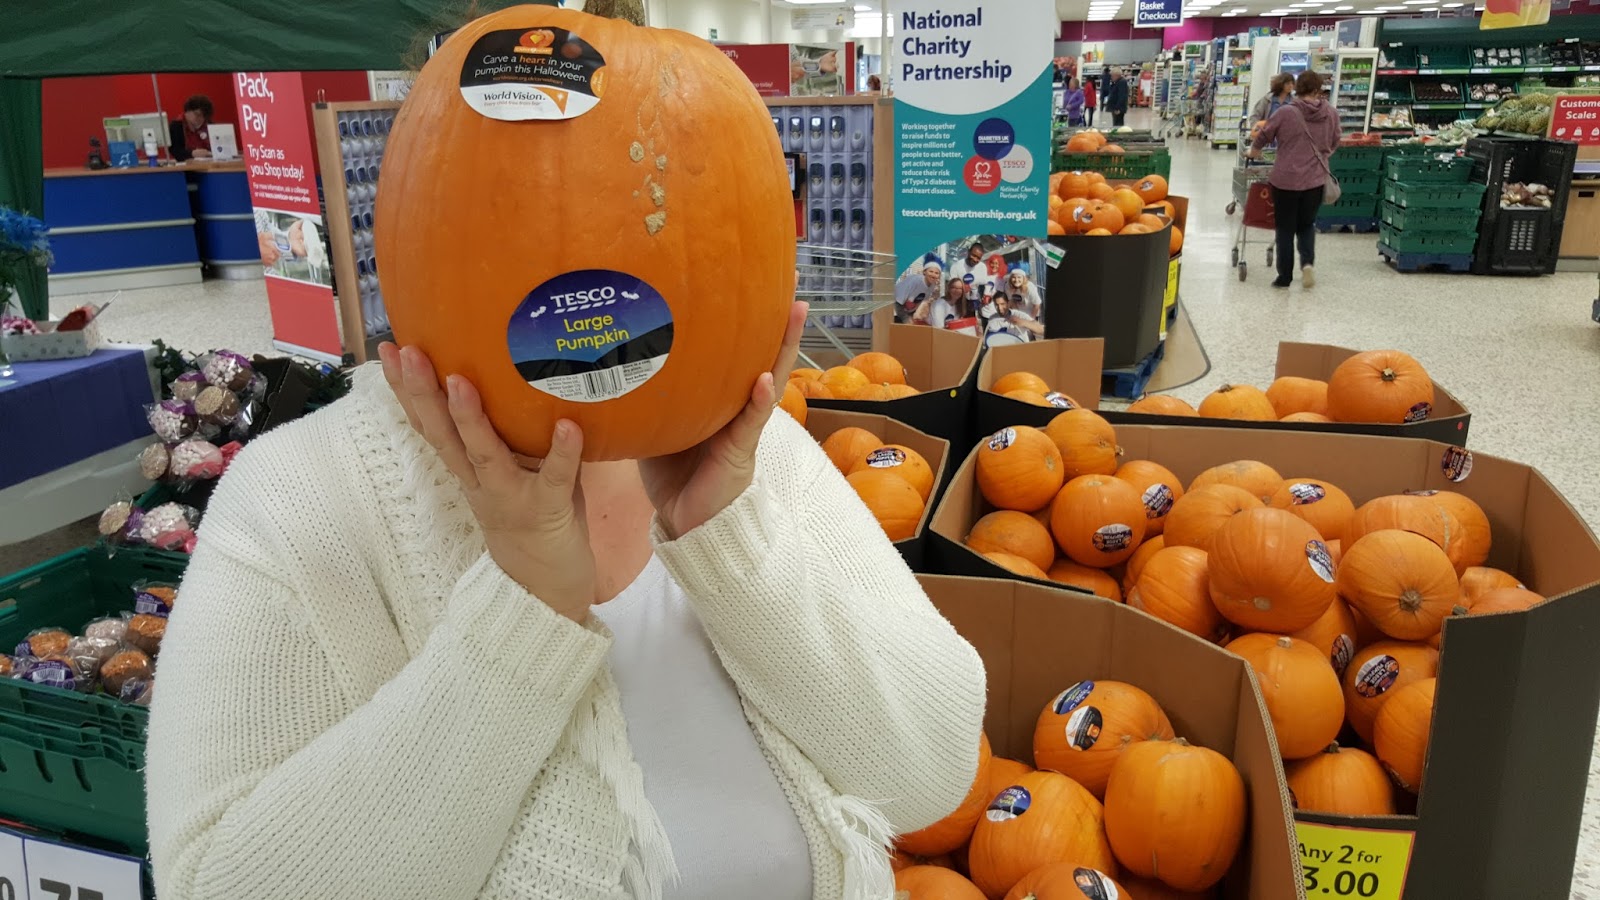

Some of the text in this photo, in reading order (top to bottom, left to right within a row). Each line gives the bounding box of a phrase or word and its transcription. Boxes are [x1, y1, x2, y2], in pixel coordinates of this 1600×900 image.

[1140, 2, 1165, 10] Basket
[903, 8, 982, 30] National
[1139, 12, 1177, 20] Checkouts
[903, 36, 971, 58] Charity
[483, 55, 508, 64] Carve
[520, 56, 546, 64] heart
[548, 57, 557, 65] in
[560, 61, 583, 71] your
[903, 60, 1012, 82] Partnership
[475, 65, 511, 78] pumpkin
[515, 65, 531, 74] this
[534, 67, 587, 83] Halloween.
[238, 72, 274, 103] Pack,
[484, 92, 511, 100] World
[242, 104, 267, 138] Pay
[1566, 111, 1596, 119] Scales
[248, 144, 285, 161] Try Scan as
[942, 151, 963, 159] better,
[250, 164, 305, 182] you Shop today!
[1000, 193, 1028, 201] Partnership
[1021, 186, 1039, 195] Charity
[902, 208, 1036, 221] tescocharitypartnership.org.uk
[550, 286, 616, 308] TESCO
[564, 314, 613, 333] Large
[556, 328, 630, 352] Pumpkin
[1299, 843, 1382, 864] Any 2 for
